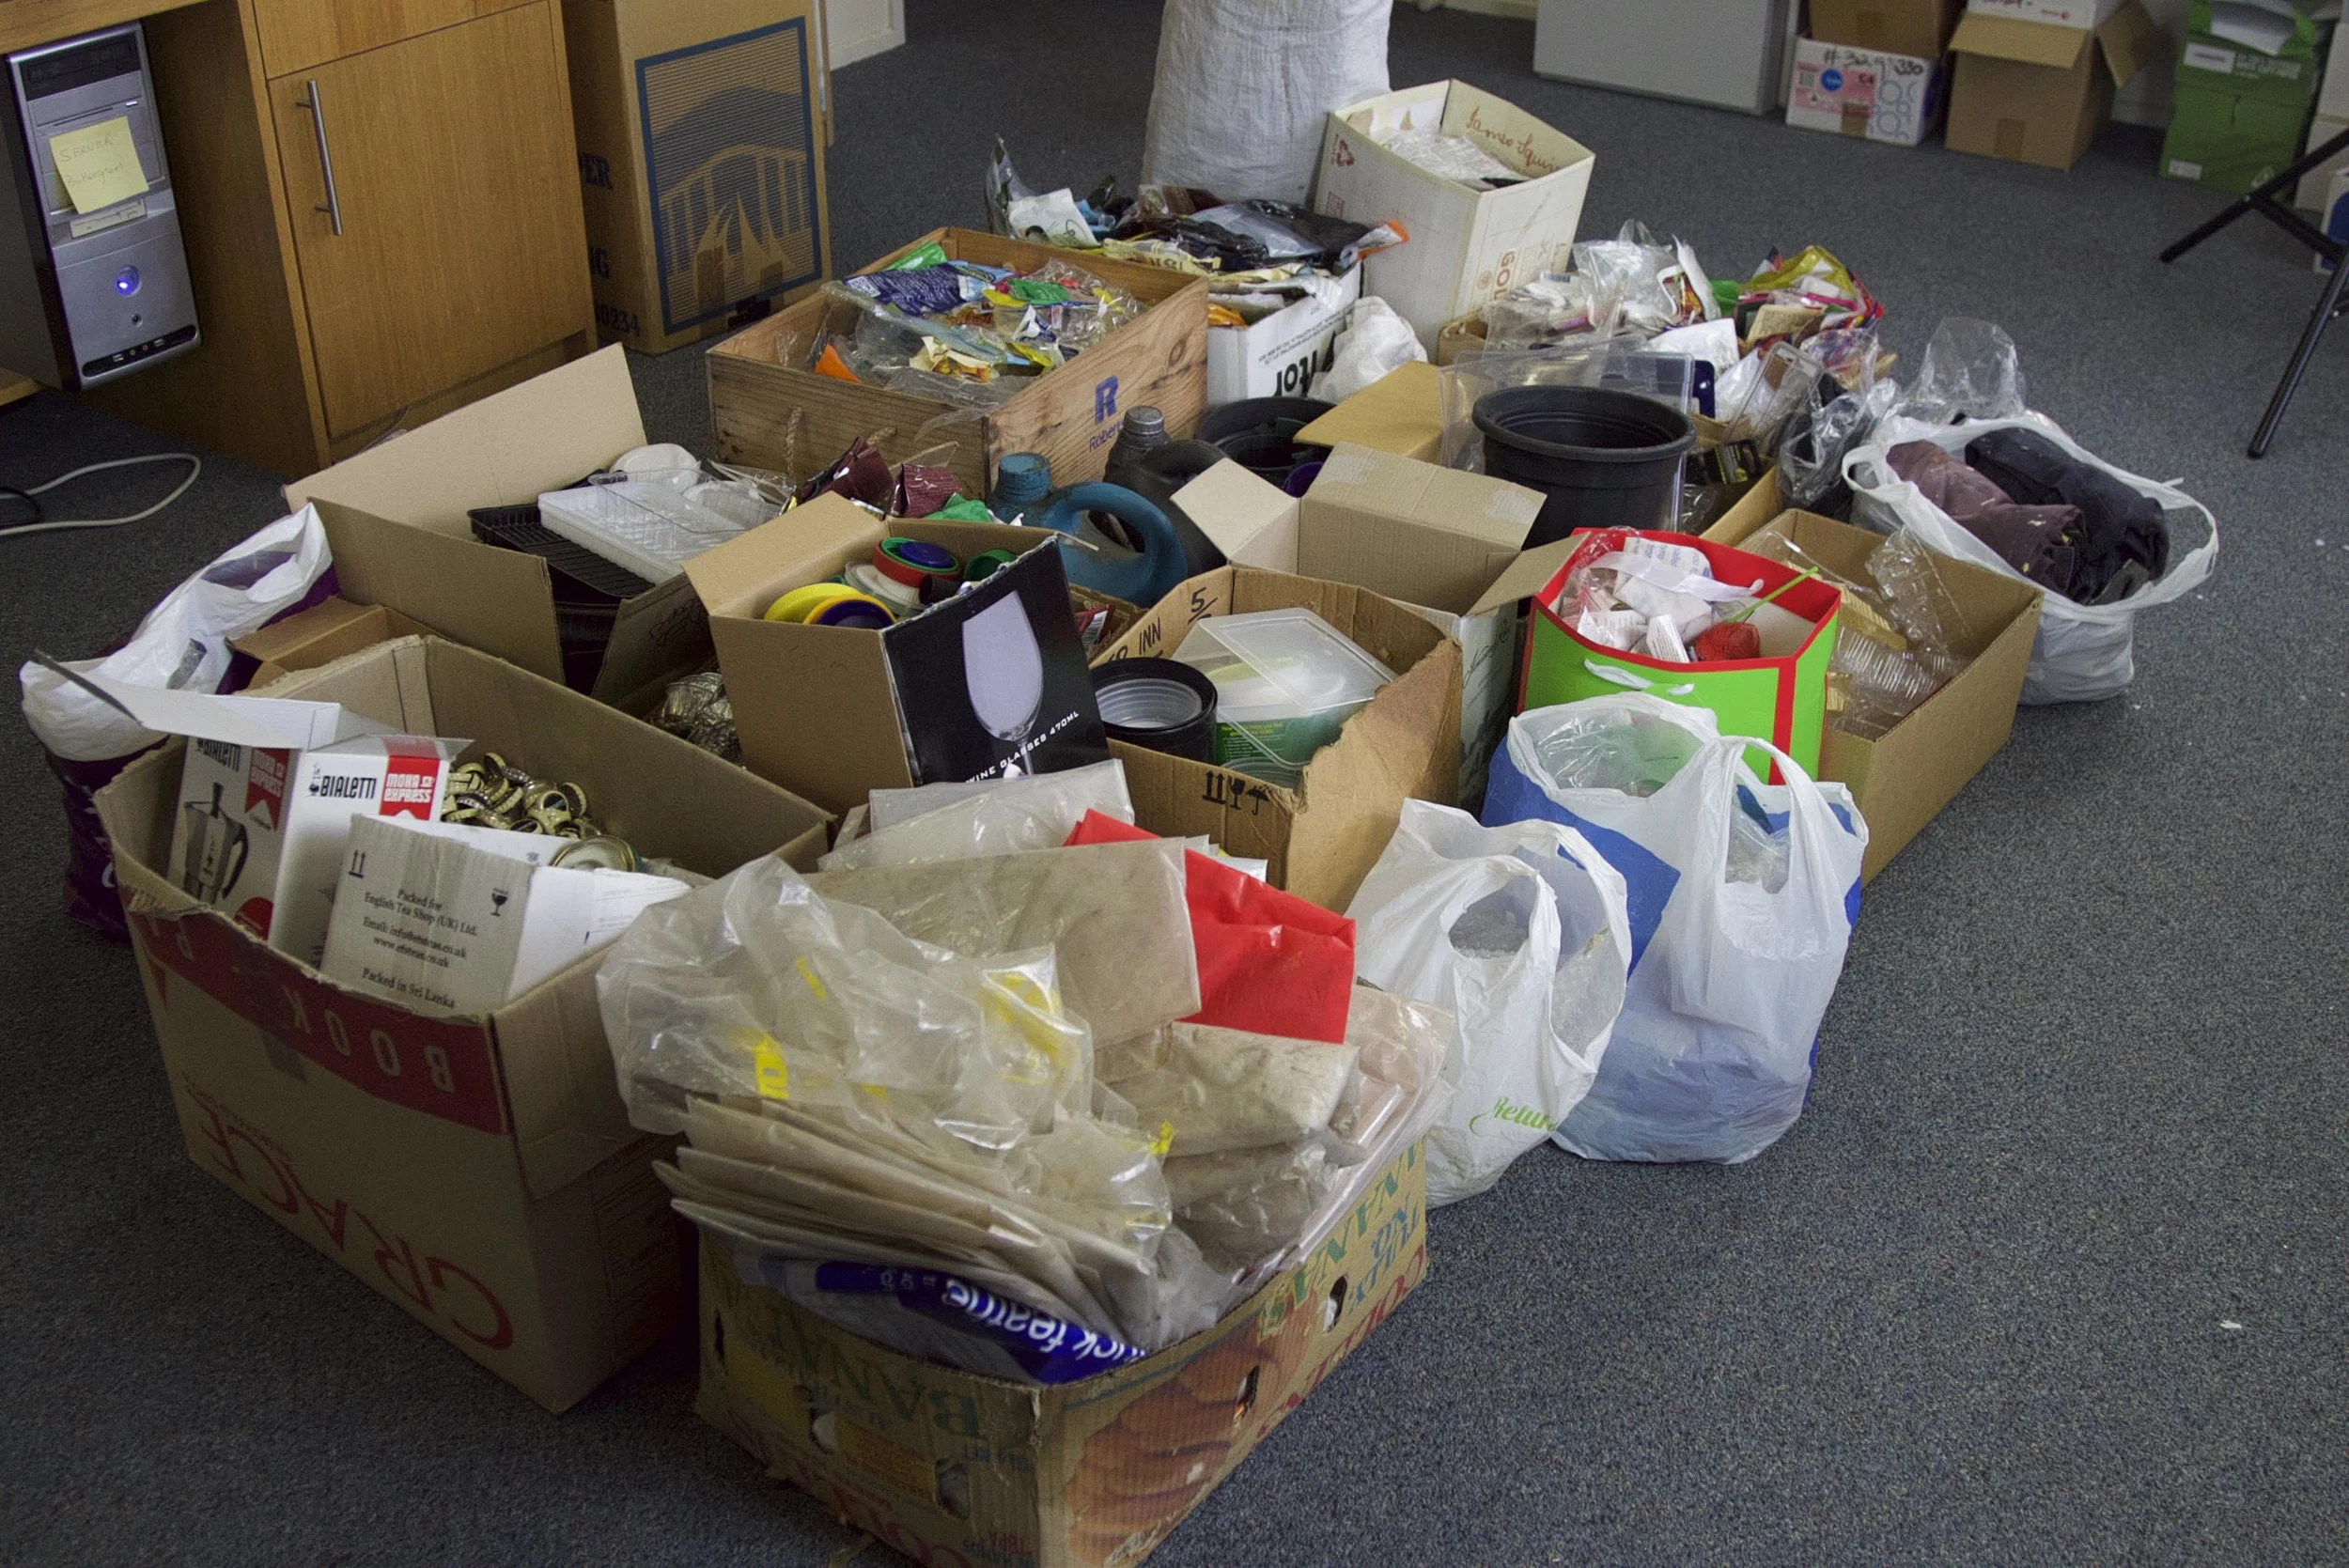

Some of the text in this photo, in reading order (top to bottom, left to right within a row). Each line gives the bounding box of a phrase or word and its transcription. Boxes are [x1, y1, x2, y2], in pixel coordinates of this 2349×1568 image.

[1095, 374, 1119, 424] R
[1138, 616, 1162, 655] INN
[1000, 734, 1047, 768] GLASSES
[1050, 711, 1080, 735] 470ML
[383, 788, 431, 803] EXPRESS
[386, 773, 420, 787] MOKA
[365, 892, 477, 937] English Tea Shop (UK) Ltd.
[397, 889, 443, 910] Packed for
[364, 916, 388, 933] Email:
[362, 967, 456, 1008] Packed in Sri Lanka
[284, 983, 455, 1093] BOOK
